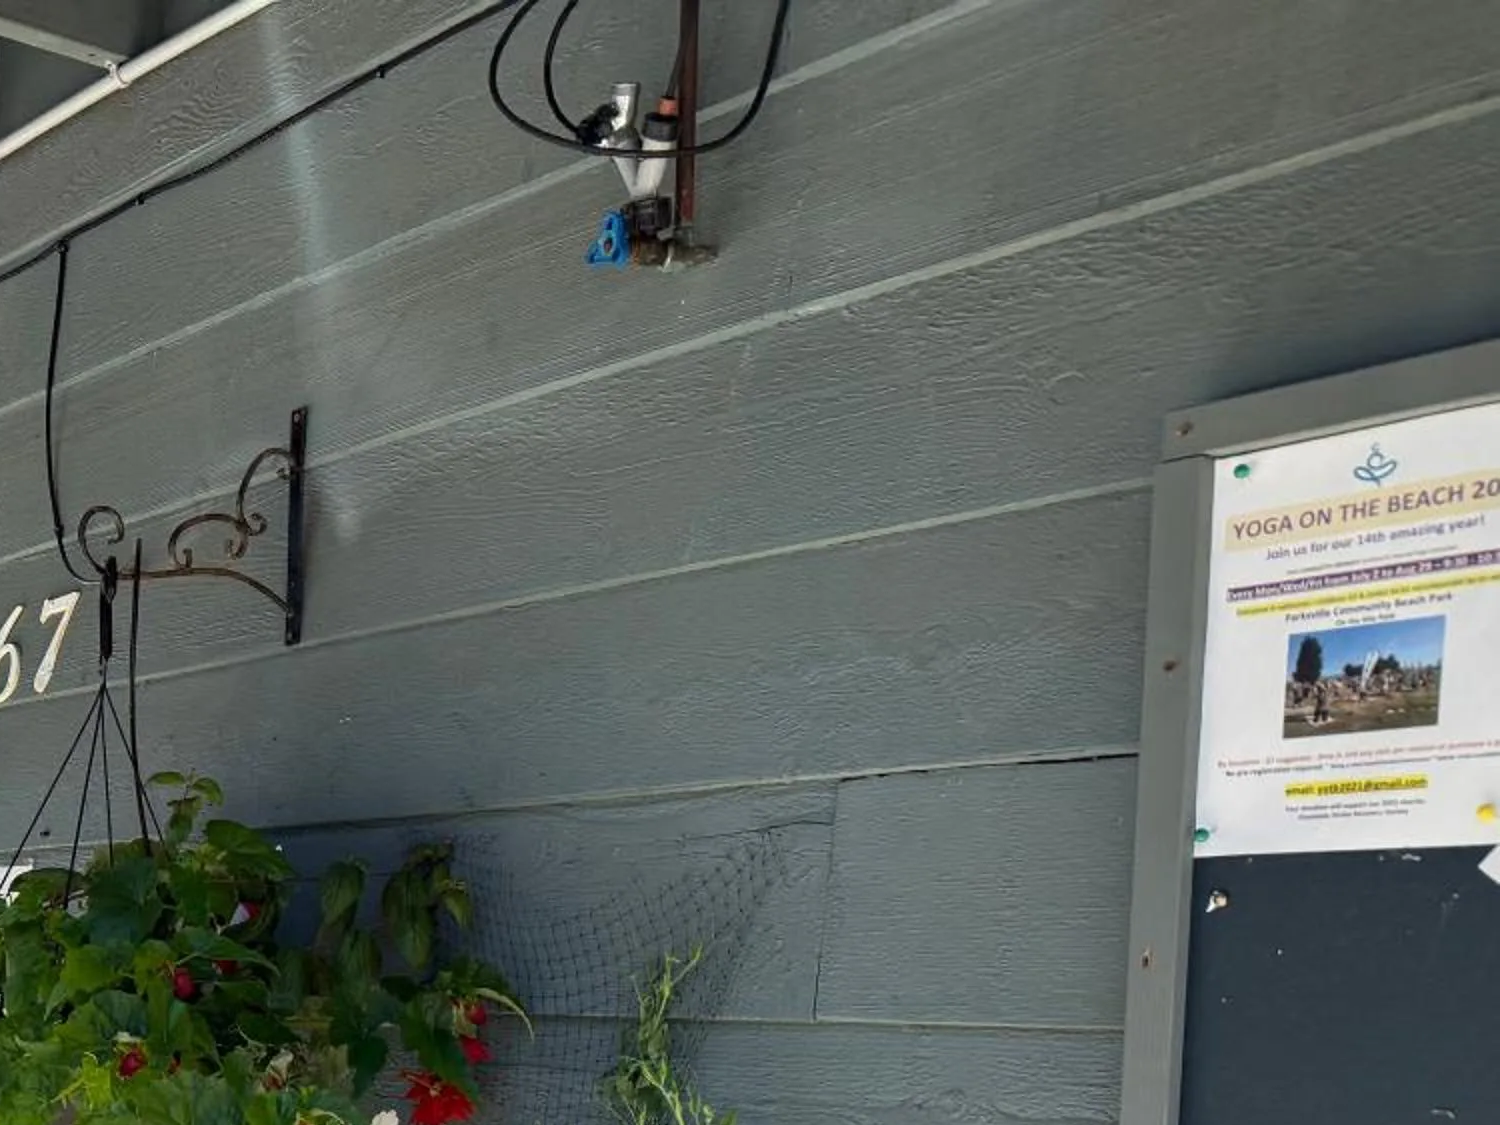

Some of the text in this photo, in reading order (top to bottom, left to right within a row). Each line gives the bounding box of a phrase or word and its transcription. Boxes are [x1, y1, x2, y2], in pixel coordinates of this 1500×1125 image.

[1233, 516, 1293, 540] YOGA
[1299, 509, 1332, 530] ON
[1340, 503, 1381, 522] THE
[1387, 484, 1464, 514] BEACH
[1266, 547, 1291, 560] Join
[1294, 545, 1308, 555] us
[1310, 542, 1329, 553] for
[1331, 539, 1352, 549] our
[1357, 532, 1386, 545] 14th
[1390, 520, 1444, 541] amazing
